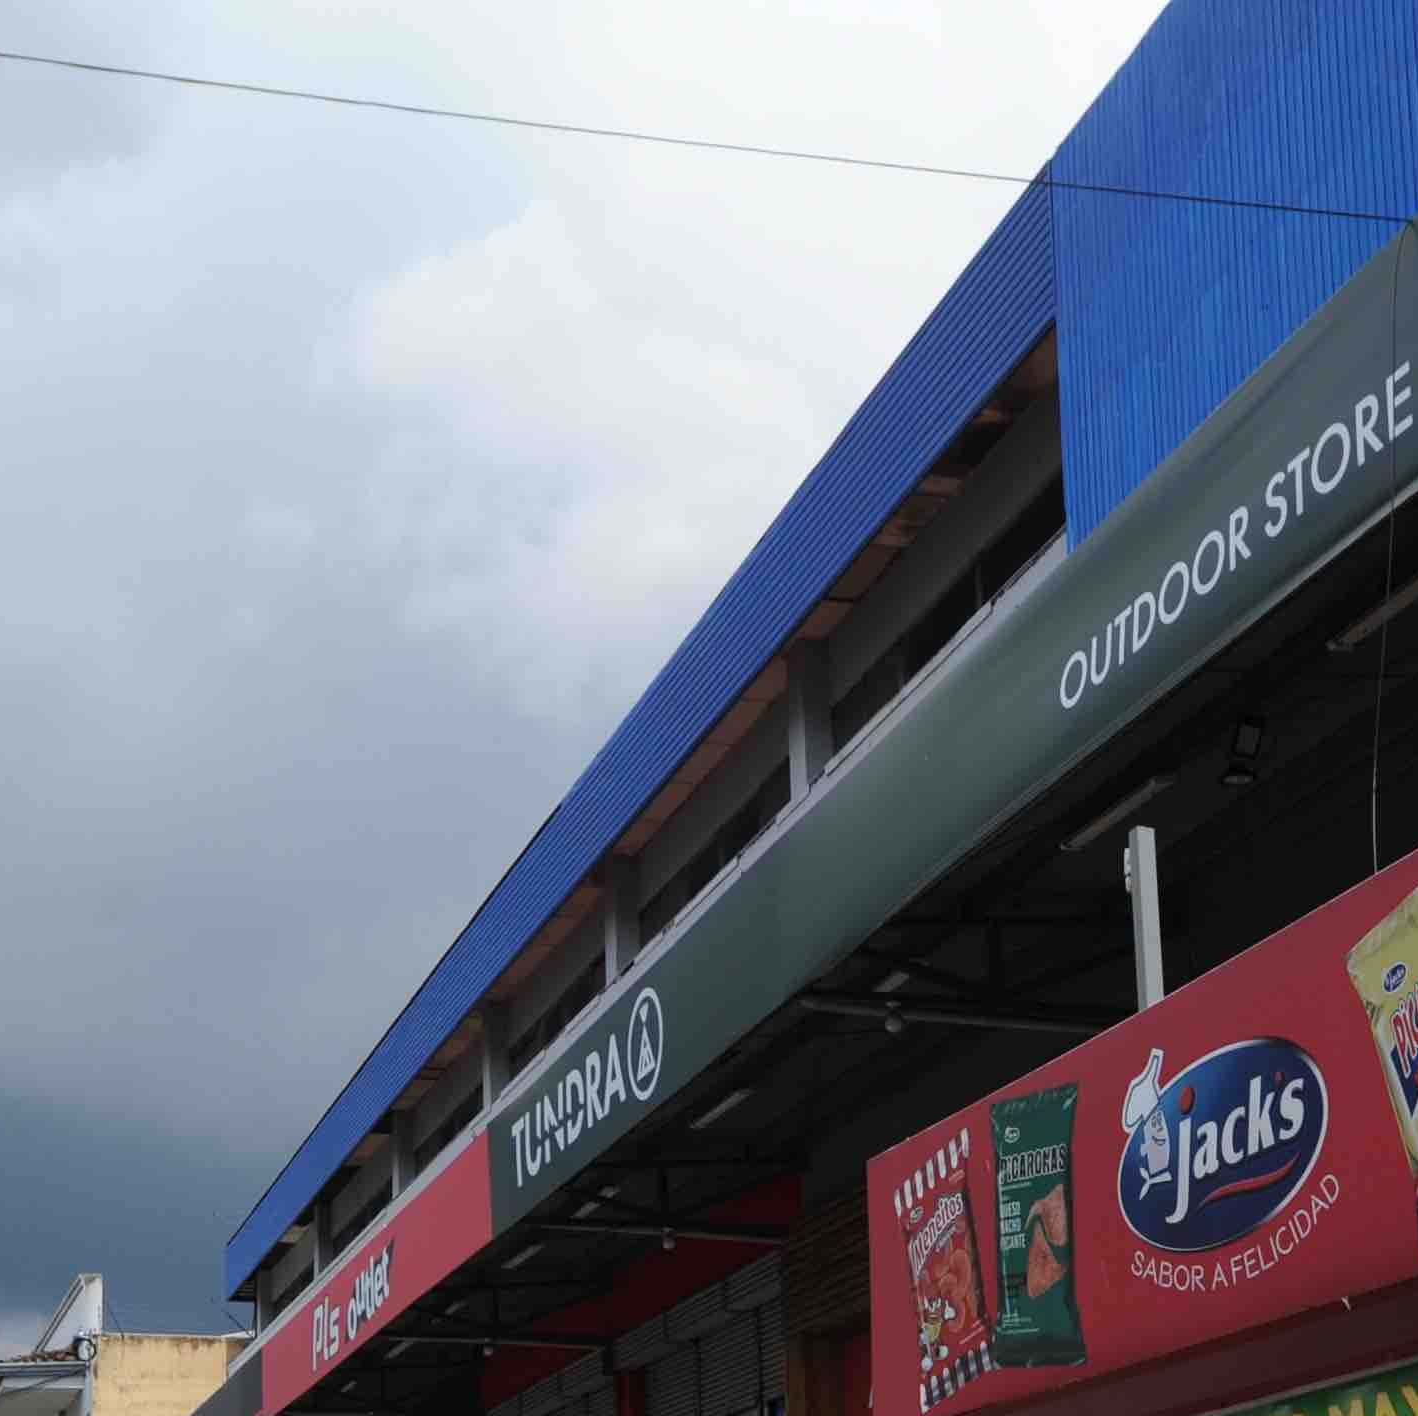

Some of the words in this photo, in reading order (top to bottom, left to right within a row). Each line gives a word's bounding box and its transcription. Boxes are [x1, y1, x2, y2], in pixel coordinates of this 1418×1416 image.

[1060, 506, 1251, 709] OUTDOOR
[1264, 361, 1413, 538] STORE
[511, 1033, 627, 1187] TUNDRA
[1130, 1249, 1205, 1291] SABOR
[1211, 1263, 1229, 1290] A
[1230, 1173, 1341, 1286] FELICIDAD
